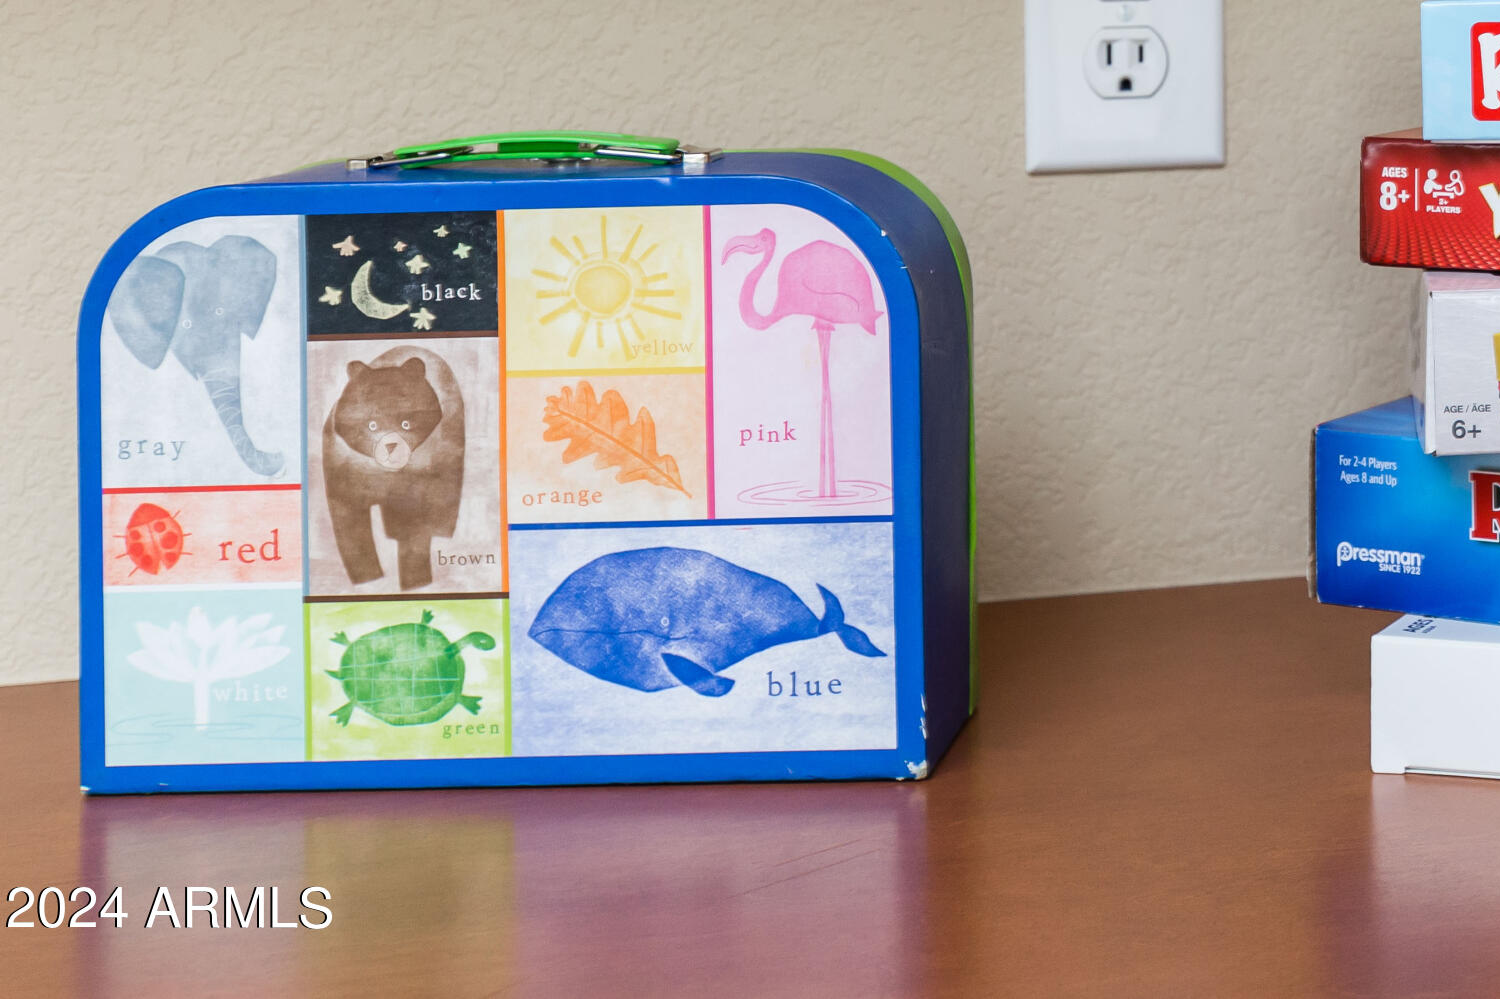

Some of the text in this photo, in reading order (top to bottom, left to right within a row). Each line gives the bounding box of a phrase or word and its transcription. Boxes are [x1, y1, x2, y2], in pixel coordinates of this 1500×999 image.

[1382, 166, 1408, 179] AGES
[1379, 181, 1410, 211] 8+
[1425, 205, 1462, 215] PLAYERS
[421, 282, 482, 302] black
[631, 338, 694, 359] yellow
[1443, 405, 1463, 413] AGE
[738, 422, 798, 444] pink
[1451, 419, 1482, 439] 6+
[117, 439, 187, 461] gray
[1339, 454, 1398, 471] For 2-4 Players
[1340, 470, 1398, 488] Ages 8 and Up
[521, 489, 603, 507] orange
[218, 528, 282, 564] red
[437, 549, 496, 568] brown
[1379, 563, 1421, 576] SINCE 1922
[213, 680, 288, 702] white
[767, 671, 843, 697] blue
[442, 721, 500, 739] green
